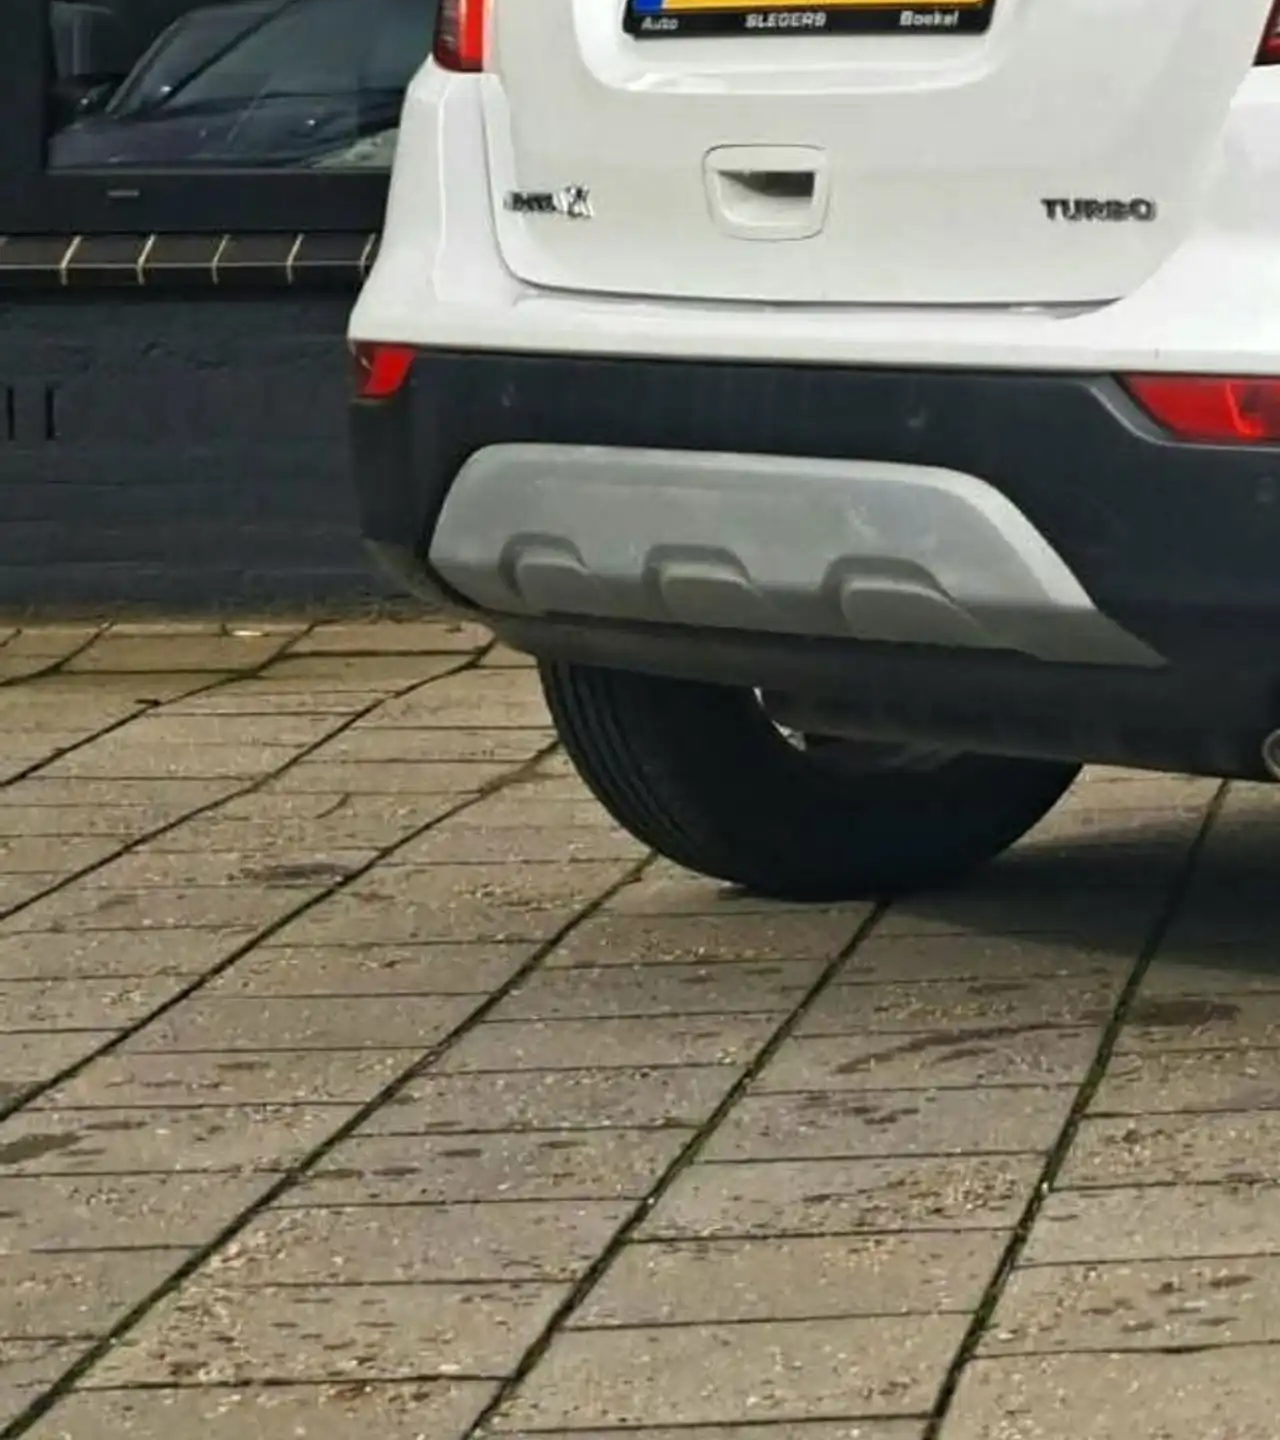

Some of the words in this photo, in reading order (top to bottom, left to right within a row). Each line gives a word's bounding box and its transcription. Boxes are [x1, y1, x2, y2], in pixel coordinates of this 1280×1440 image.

[640, 15, 679, 31] Auto
[744, 11, 828, 29] SLEGERS
[898, 9, 959, 27] Boekel
[1040, 197, 1155, 222] TURBO
